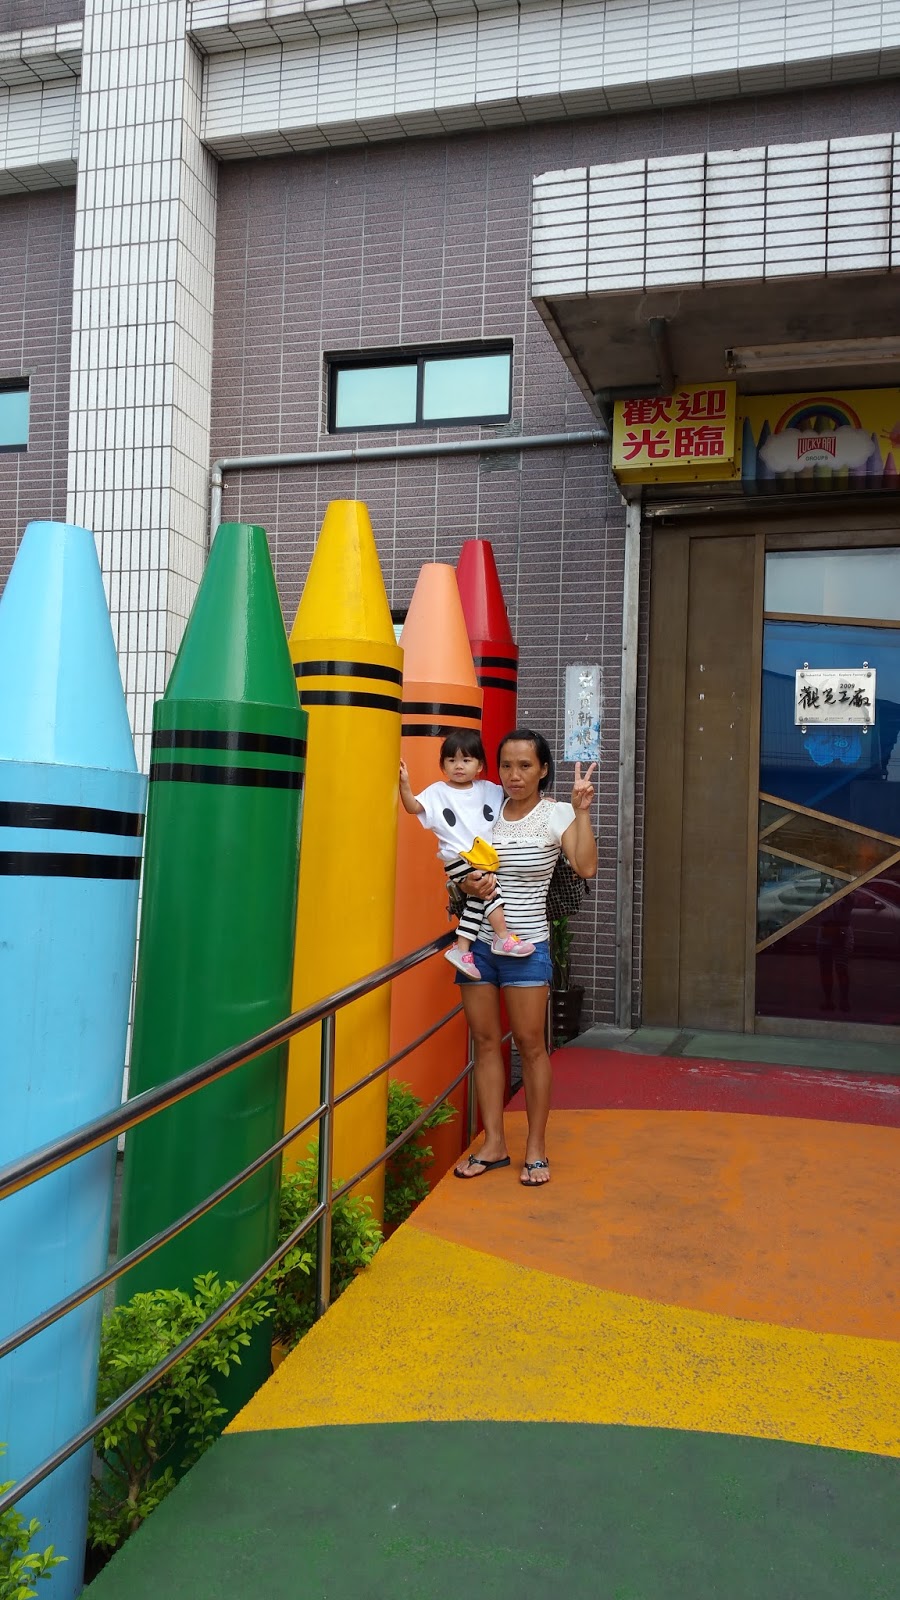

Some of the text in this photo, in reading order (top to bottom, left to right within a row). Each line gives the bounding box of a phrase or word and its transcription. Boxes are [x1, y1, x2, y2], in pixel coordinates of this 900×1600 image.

[622, 390, 726, 425] 歡迎
[622, 426, 726, 460] 光臨
[798, 437, 836, 457] LUCKY ART
